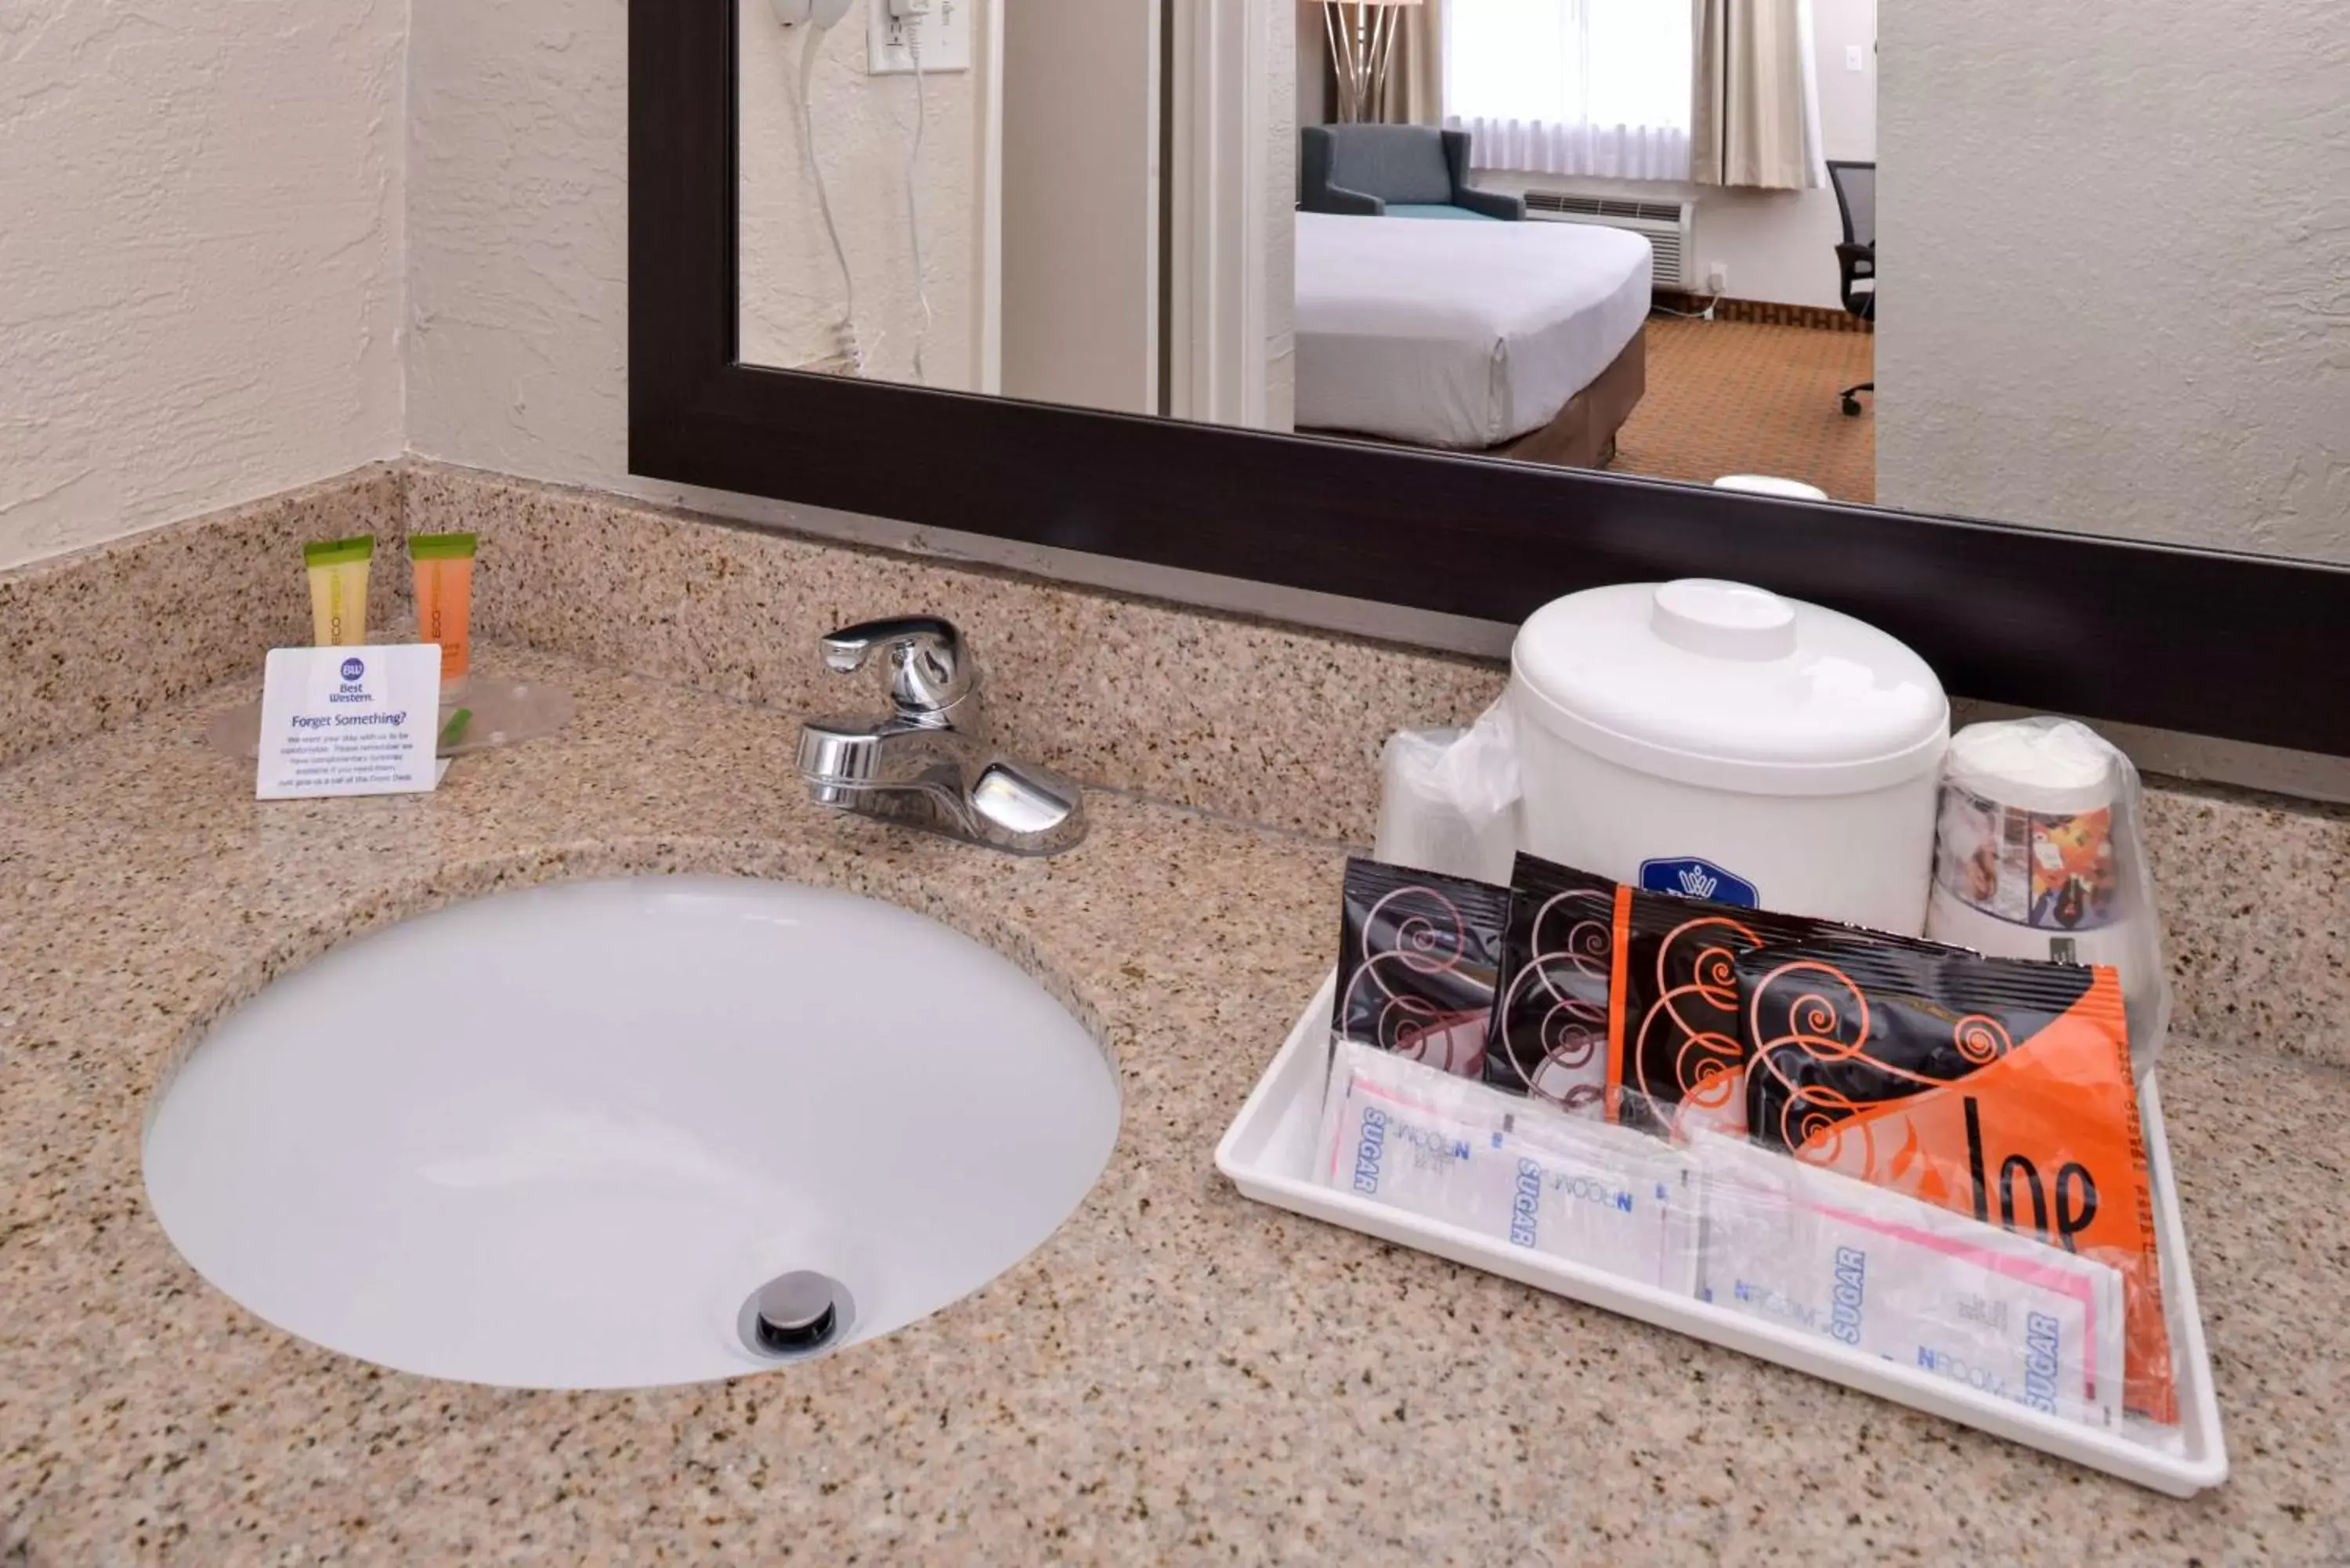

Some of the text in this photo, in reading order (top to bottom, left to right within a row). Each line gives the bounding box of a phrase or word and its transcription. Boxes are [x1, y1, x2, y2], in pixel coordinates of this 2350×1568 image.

[432, 611, 441, 638] ECO
[292, 711, 407, 728] Forget Something?
[339, 683, 363, 693] Best
[1354, 1107, 1386, 1194] SUGAR
[1509, 1158, 1543, 1248] SUGAR
[1831, 1246, 1865, 1346] SUGAR
[2022, 1311, 2059, 1418] SUGAR
